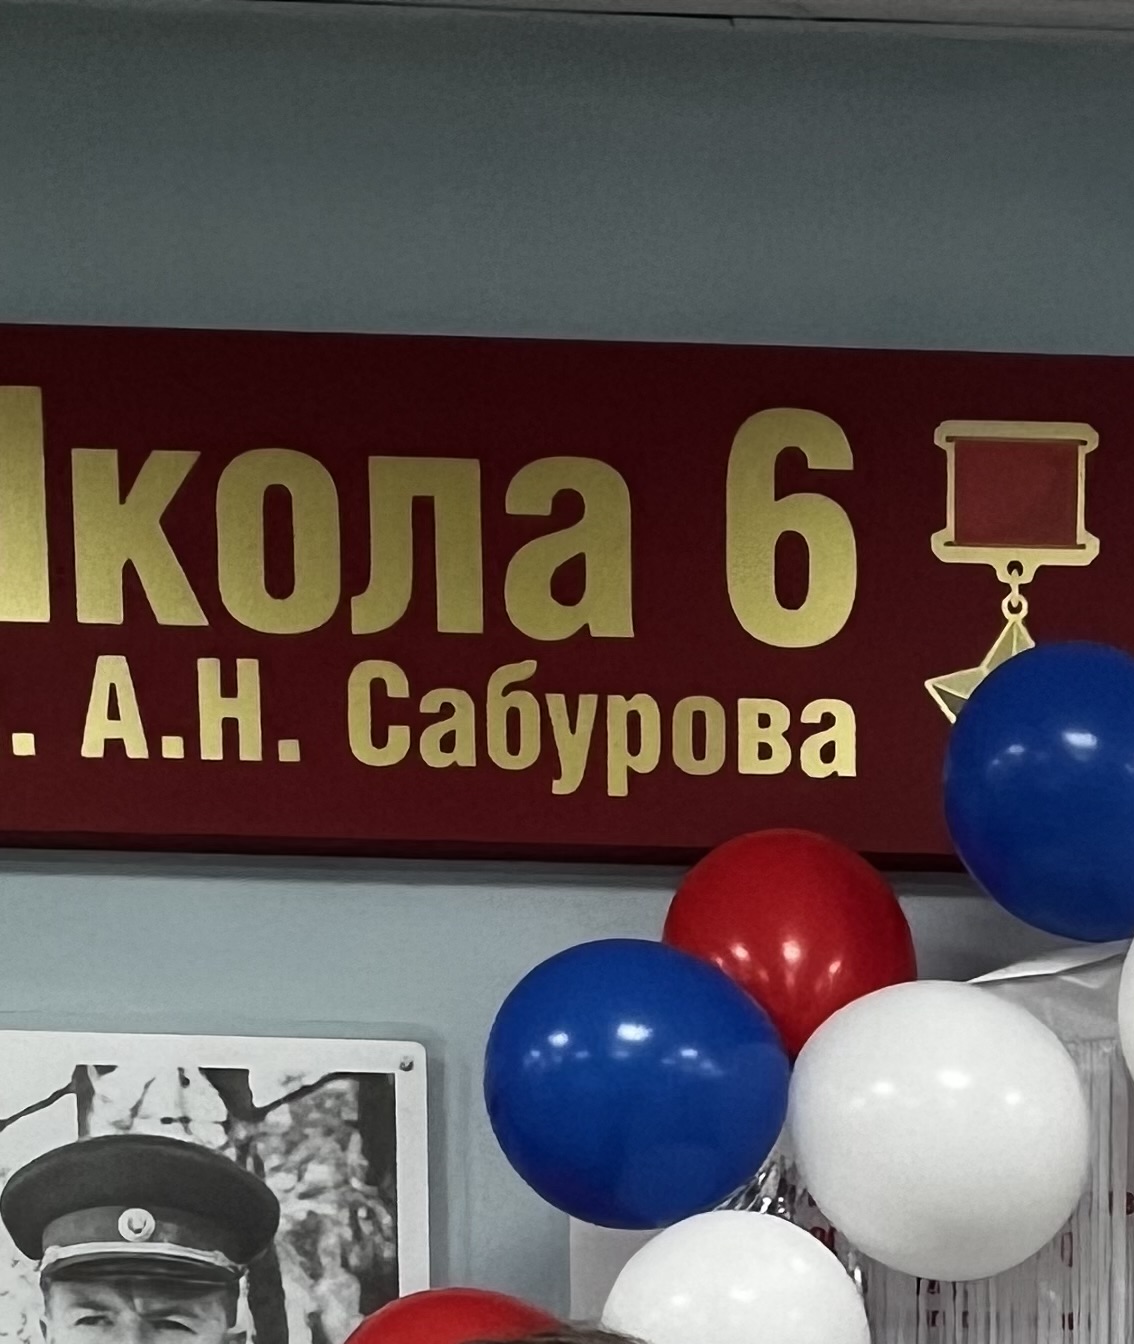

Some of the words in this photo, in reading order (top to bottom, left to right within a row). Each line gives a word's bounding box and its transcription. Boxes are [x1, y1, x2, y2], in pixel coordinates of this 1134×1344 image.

[725, 407, 858, 648] 6
[80, 655, 302, 762] А.Н.
[347, 659, 858, 797] Сабурова
